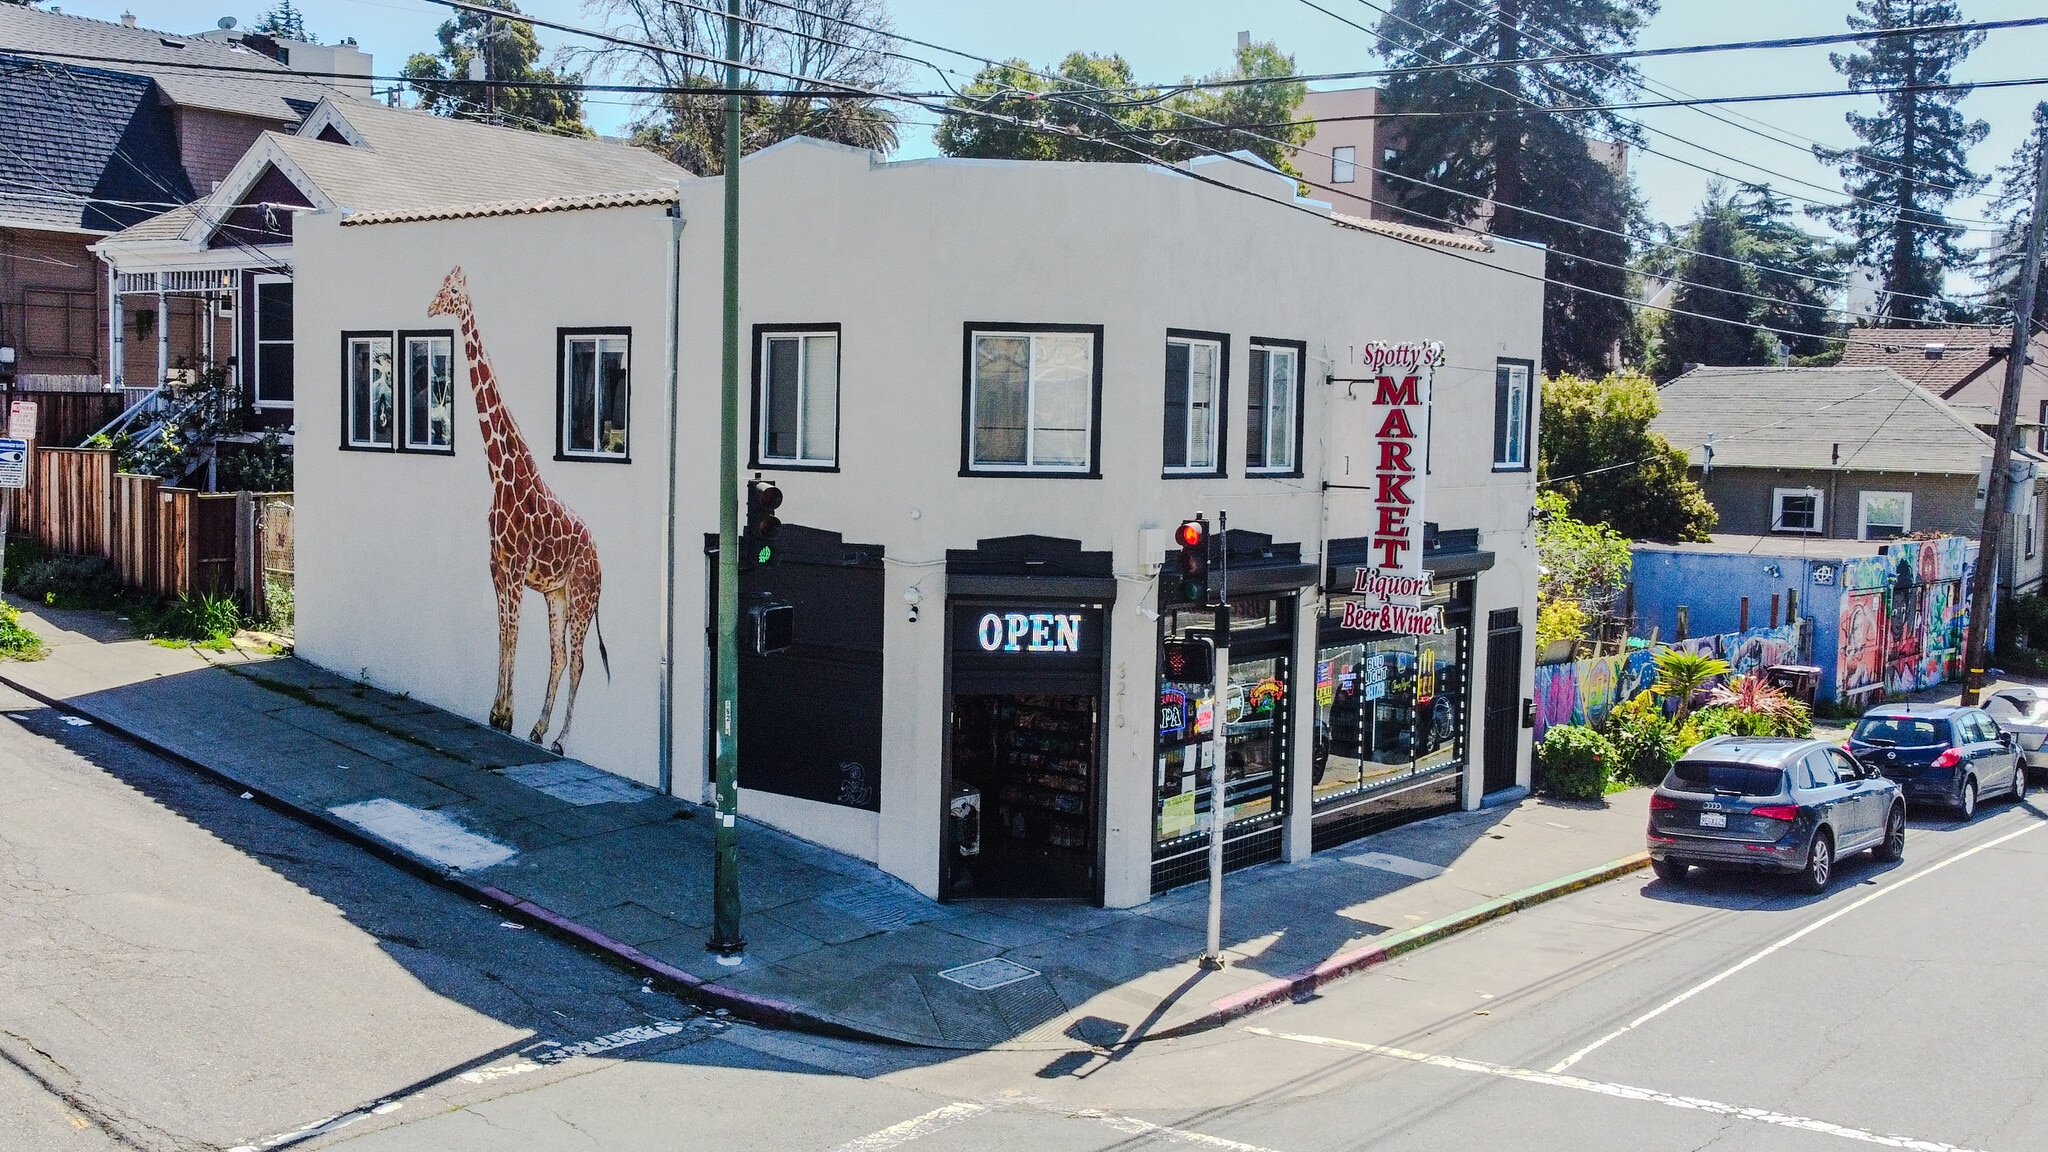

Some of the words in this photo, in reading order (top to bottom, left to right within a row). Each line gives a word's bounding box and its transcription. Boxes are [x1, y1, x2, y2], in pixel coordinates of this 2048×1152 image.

[1363, 341, 1433, 373] Spotty's
[1372, 375, 1421, 569] MARKET
[1354, 568, 1423, 601] Liquor
[979, 613, 1082, 652] OPEN
[1367, 655, 1385, 671] BUD
